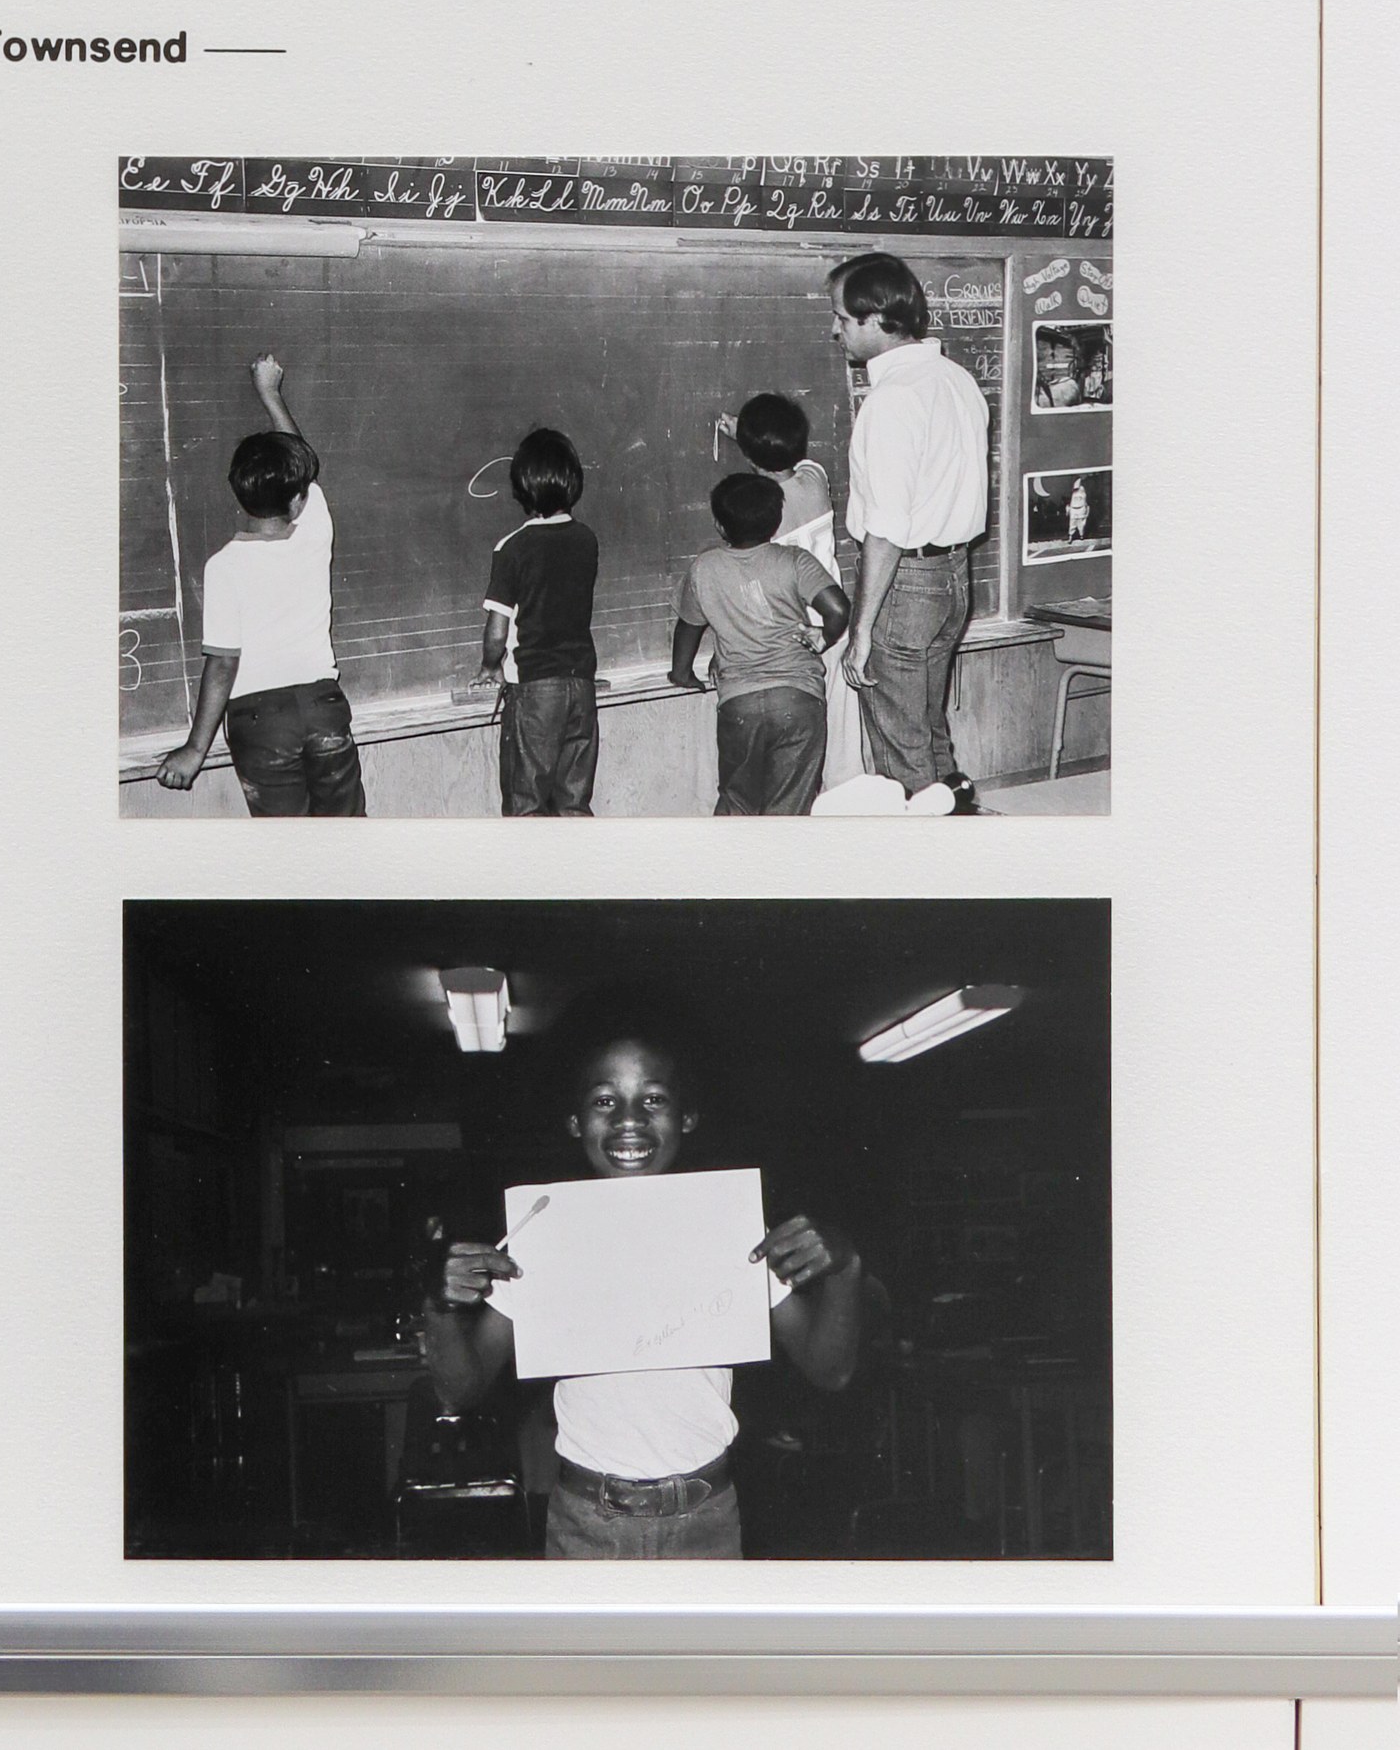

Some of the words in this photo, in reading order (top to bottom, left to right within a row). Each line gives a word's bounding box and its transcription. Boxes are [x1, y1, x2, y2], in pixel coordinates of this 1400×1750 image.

[1002, 158, 1041, 184] Ww
[1044, 161, 1065, 186] Xx
[1075, 161, 1097, 196] Yy
[121, 156, 170, 191] Ee
[181, 160, 235, 209] Ff
[252, 164, 306, 212] Gg
[308, 167, 359, 200] Hh
[374, 171, 419, 203] Ii
[426, 174, 465, 217] Jj
[481, 176, 532, 208] Kk
[529, 180, 577, 212] Ll
[581, 181, 635, 211] Mm
[681, 185, 714, 214] Oo
[721, 187, 756, 226] Pp
[807, 191, 843, 219] Rr
[850, 194, 881, 221] Ss
[889, 196, 917, 222] Tt
[925, 196, 961, 222] Uu
[1000, 199, 1028, 224] Ww
[1069, 201, 1099, 237] Yy
[1042, 263, 1069, 282] Voltage
[1036, 295, 1058, 312] Walk
[950, 310, 1003, 325] FRIENDS
